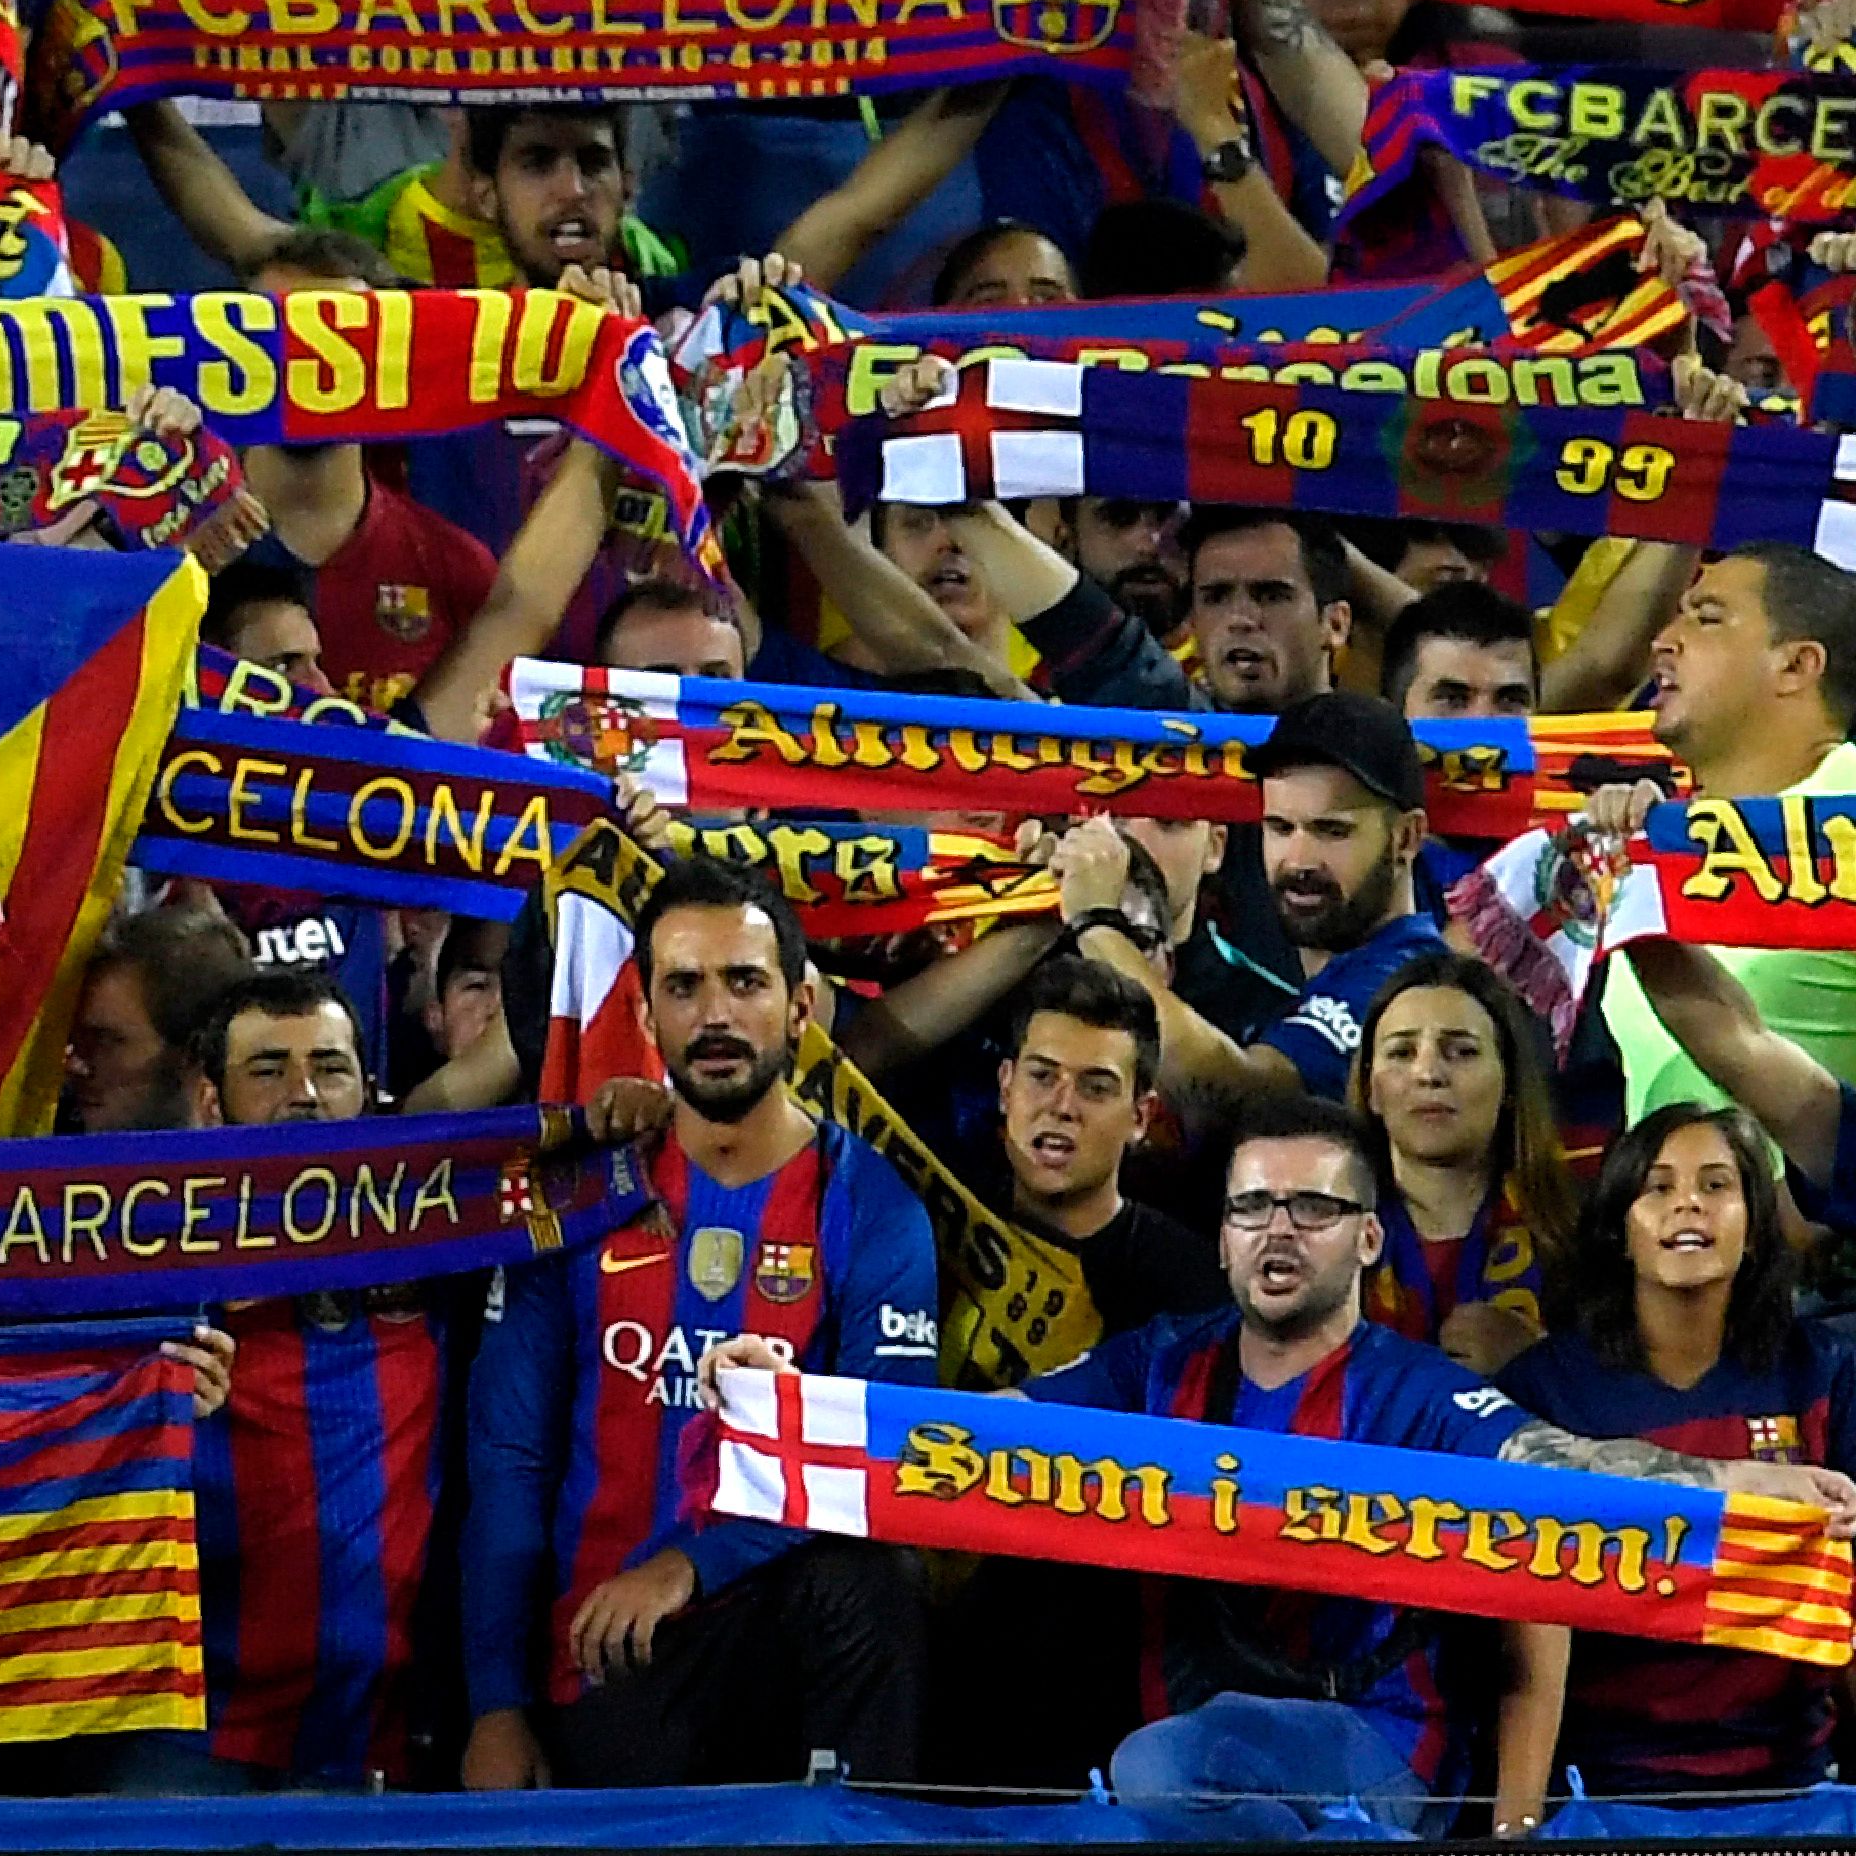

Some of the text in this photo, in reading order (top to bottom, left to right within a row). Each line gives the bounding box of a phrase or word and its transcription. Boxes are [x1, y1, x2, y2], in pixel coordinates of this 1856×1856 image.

[1451, 74, 1856, 156] FCBARCE
[460, 287, 608, 401] 10
[157, 749, 554, 878] CELONA
[601, 1319, 800, 1374] QATR
[893, 1420, 1690, 1598] Som i serem!
